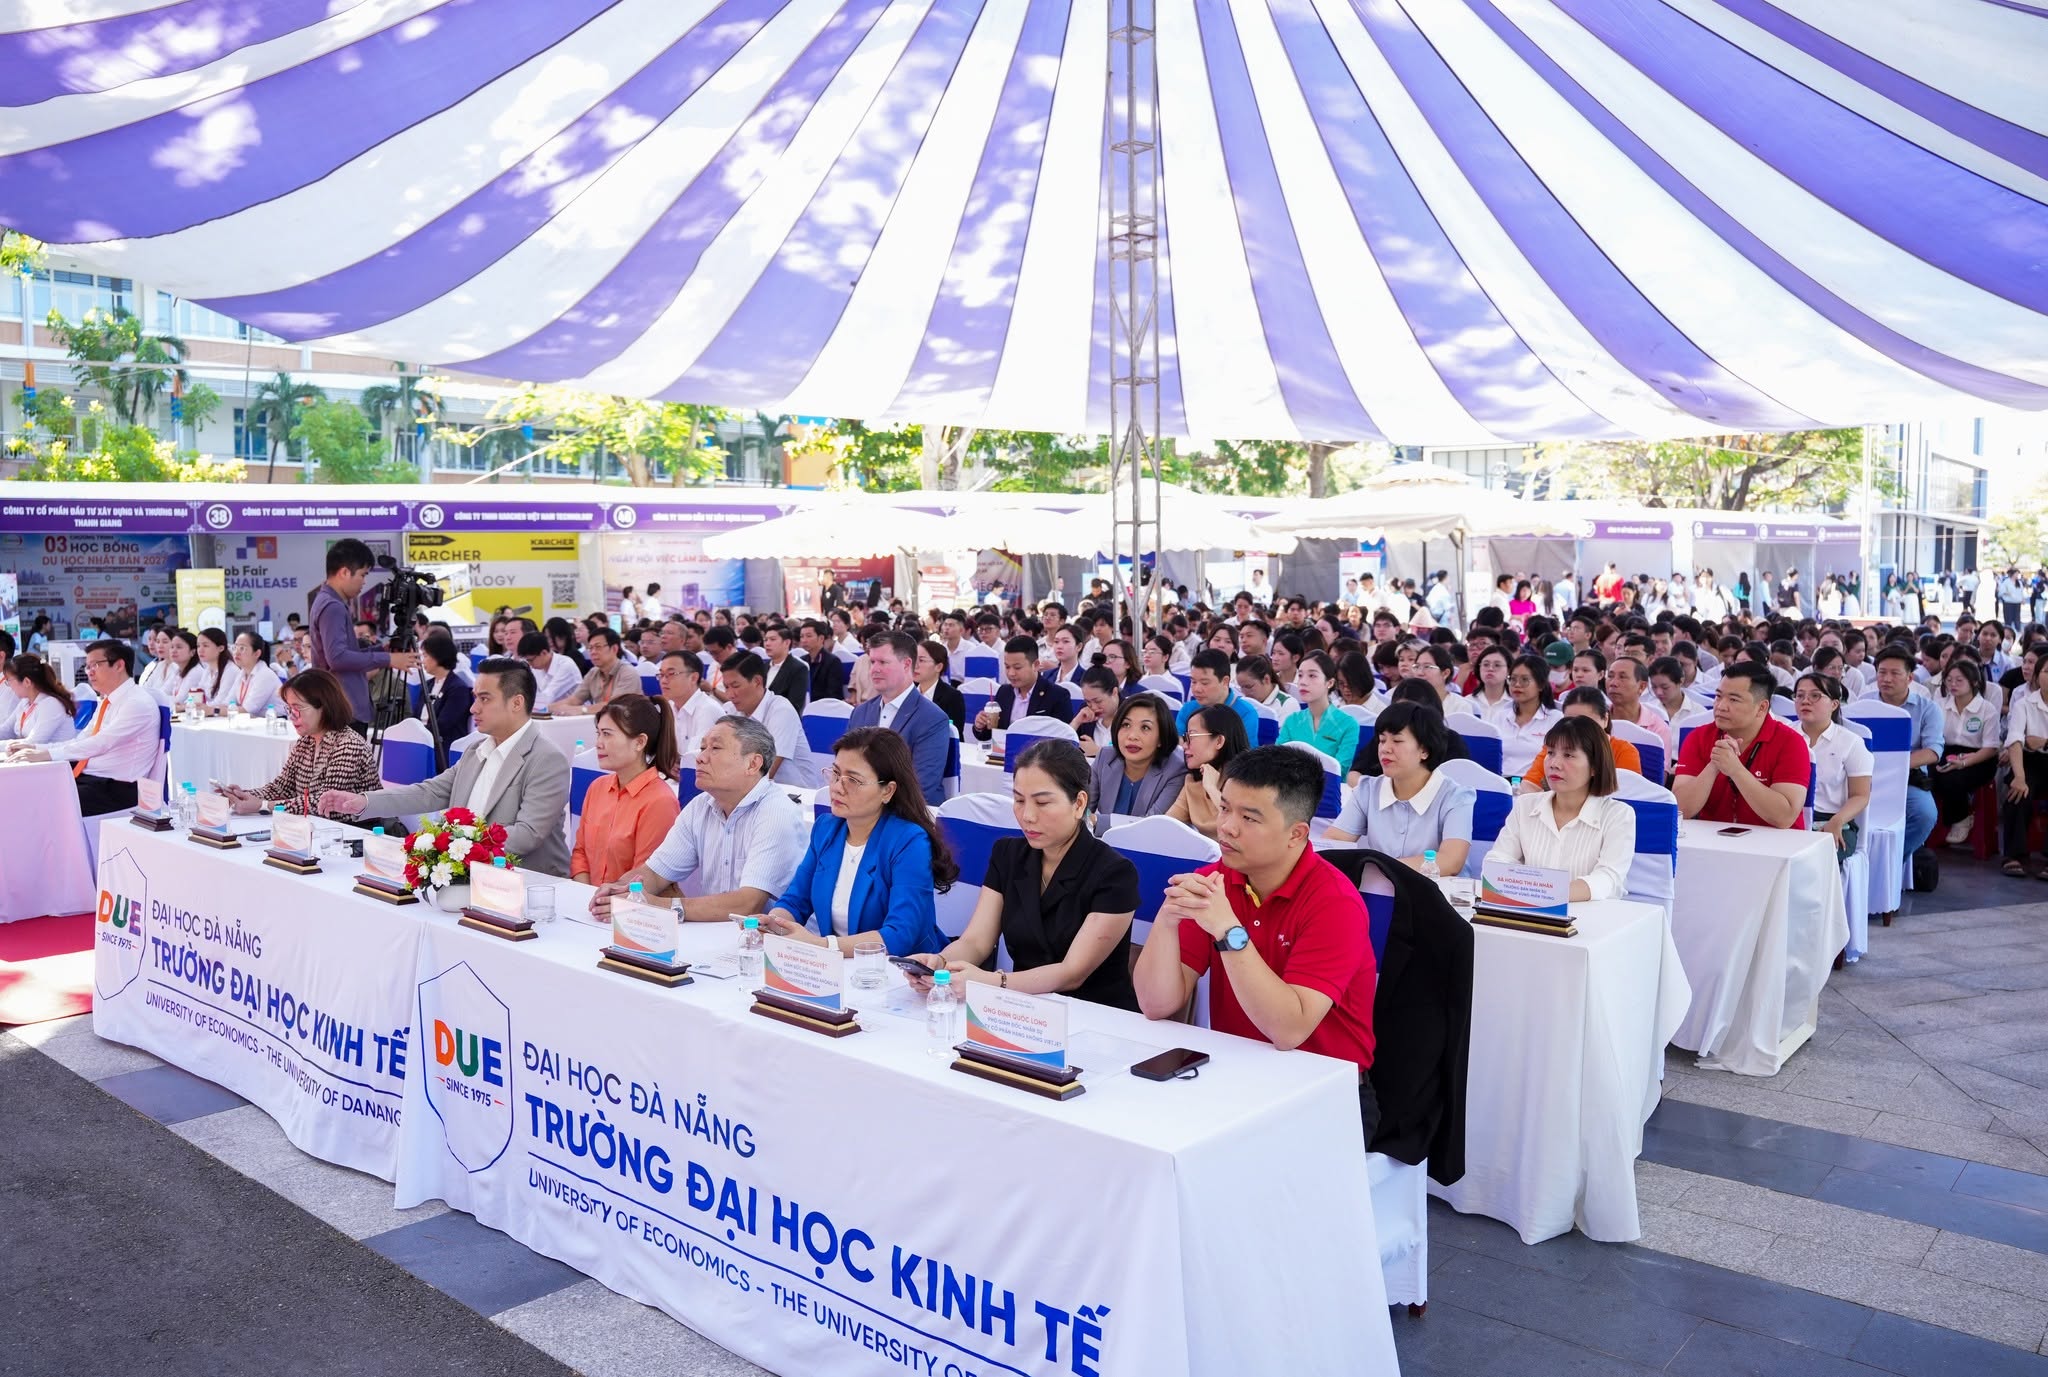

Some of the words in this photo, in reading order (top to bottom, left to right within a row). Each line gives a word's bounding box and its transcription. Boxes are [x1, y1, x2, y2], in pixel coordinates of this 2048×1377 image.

[26, 507, 34, 515] TY
[211, 509, 228, 524] 38
[74, 519, 98, 527] THANH
[100, 519, 122, 527] GIANG
[44, 536, 67, 553] 03
[70, 543, 98, 554] HỌC
[42, 556, 57, 565] DU
[61, 556, 84, 567] HỌC
[143, 555, 167, 565] 2027
[218, 565, 240, 576] ob
[242, 566, 268, 576] Fair
[226, 592, 252, 601] 026
[98, 890, 142, 936] DUE
[101, 931, 118, 944] SINCE
[118, 937, 132, 950] 1975
[152, 900, 171, 930] ĐẠI
[174, 907, 200, 938] HỌC
[204, 916, 222, 944] ĐÀ
[225, 919, 262, 959] NẴNG
[152, 936, 225, 995] TRƯỜNG
[230, 967, 261, 1019] ĐẠI
[267, 983, 310, 1040] HỌC
[312, 1008, 364, 1066] KINH
[373, 1026, 411, 1080] TẾ
[983, 1005, 996, 1015] ÔNG
[1012, 1012, 1030, 1022] QUỐC
[1031, 1017, 1048, 1027] LONG
[145, 990, 194, 1026] UNIVERSITY
[195, 1010, 207, 1028] OF
[208, 1017, 259, 1053] ECONOMICS
[266, 1044, 282, 1069] THE
[283, 1056, 321, 1098] UNIVERSITY
[322, 1086, 338, 1109] OF
[342, 1095, 402, 1127] DANANG
[434, 1018, 503, 1087] DUE
[446, 1077, 470, 1100] SINCE
[471, 1087, 492, 1107] 1975
[523, 1041, 560, 1085] ĐẠI
[568, 1057, 622, 1104] HỌC
[630, 1082, 666, 1124] ĐÀ
[674, 1093, 756, 1158] NẴNG
[525, 1092, 674, 1194] TRƯỜNG
[686, 1161, 756, 1241] ĐẠI
[772, 1194, 875, 1283] HỌC
[892, 1244, 1016, 1347] KINH
[1035, 1300, 1111, 1377] TẾ
[529, 1167, 612, 1223] UNIVERSITY
[616, 1210, 638, 1234] OF
[644, 1221, 750, 1291] ECONOMICS
[771, 1282, 808, 1317] THE
[813, 1301, 938, 1377] UNIVERSITY
